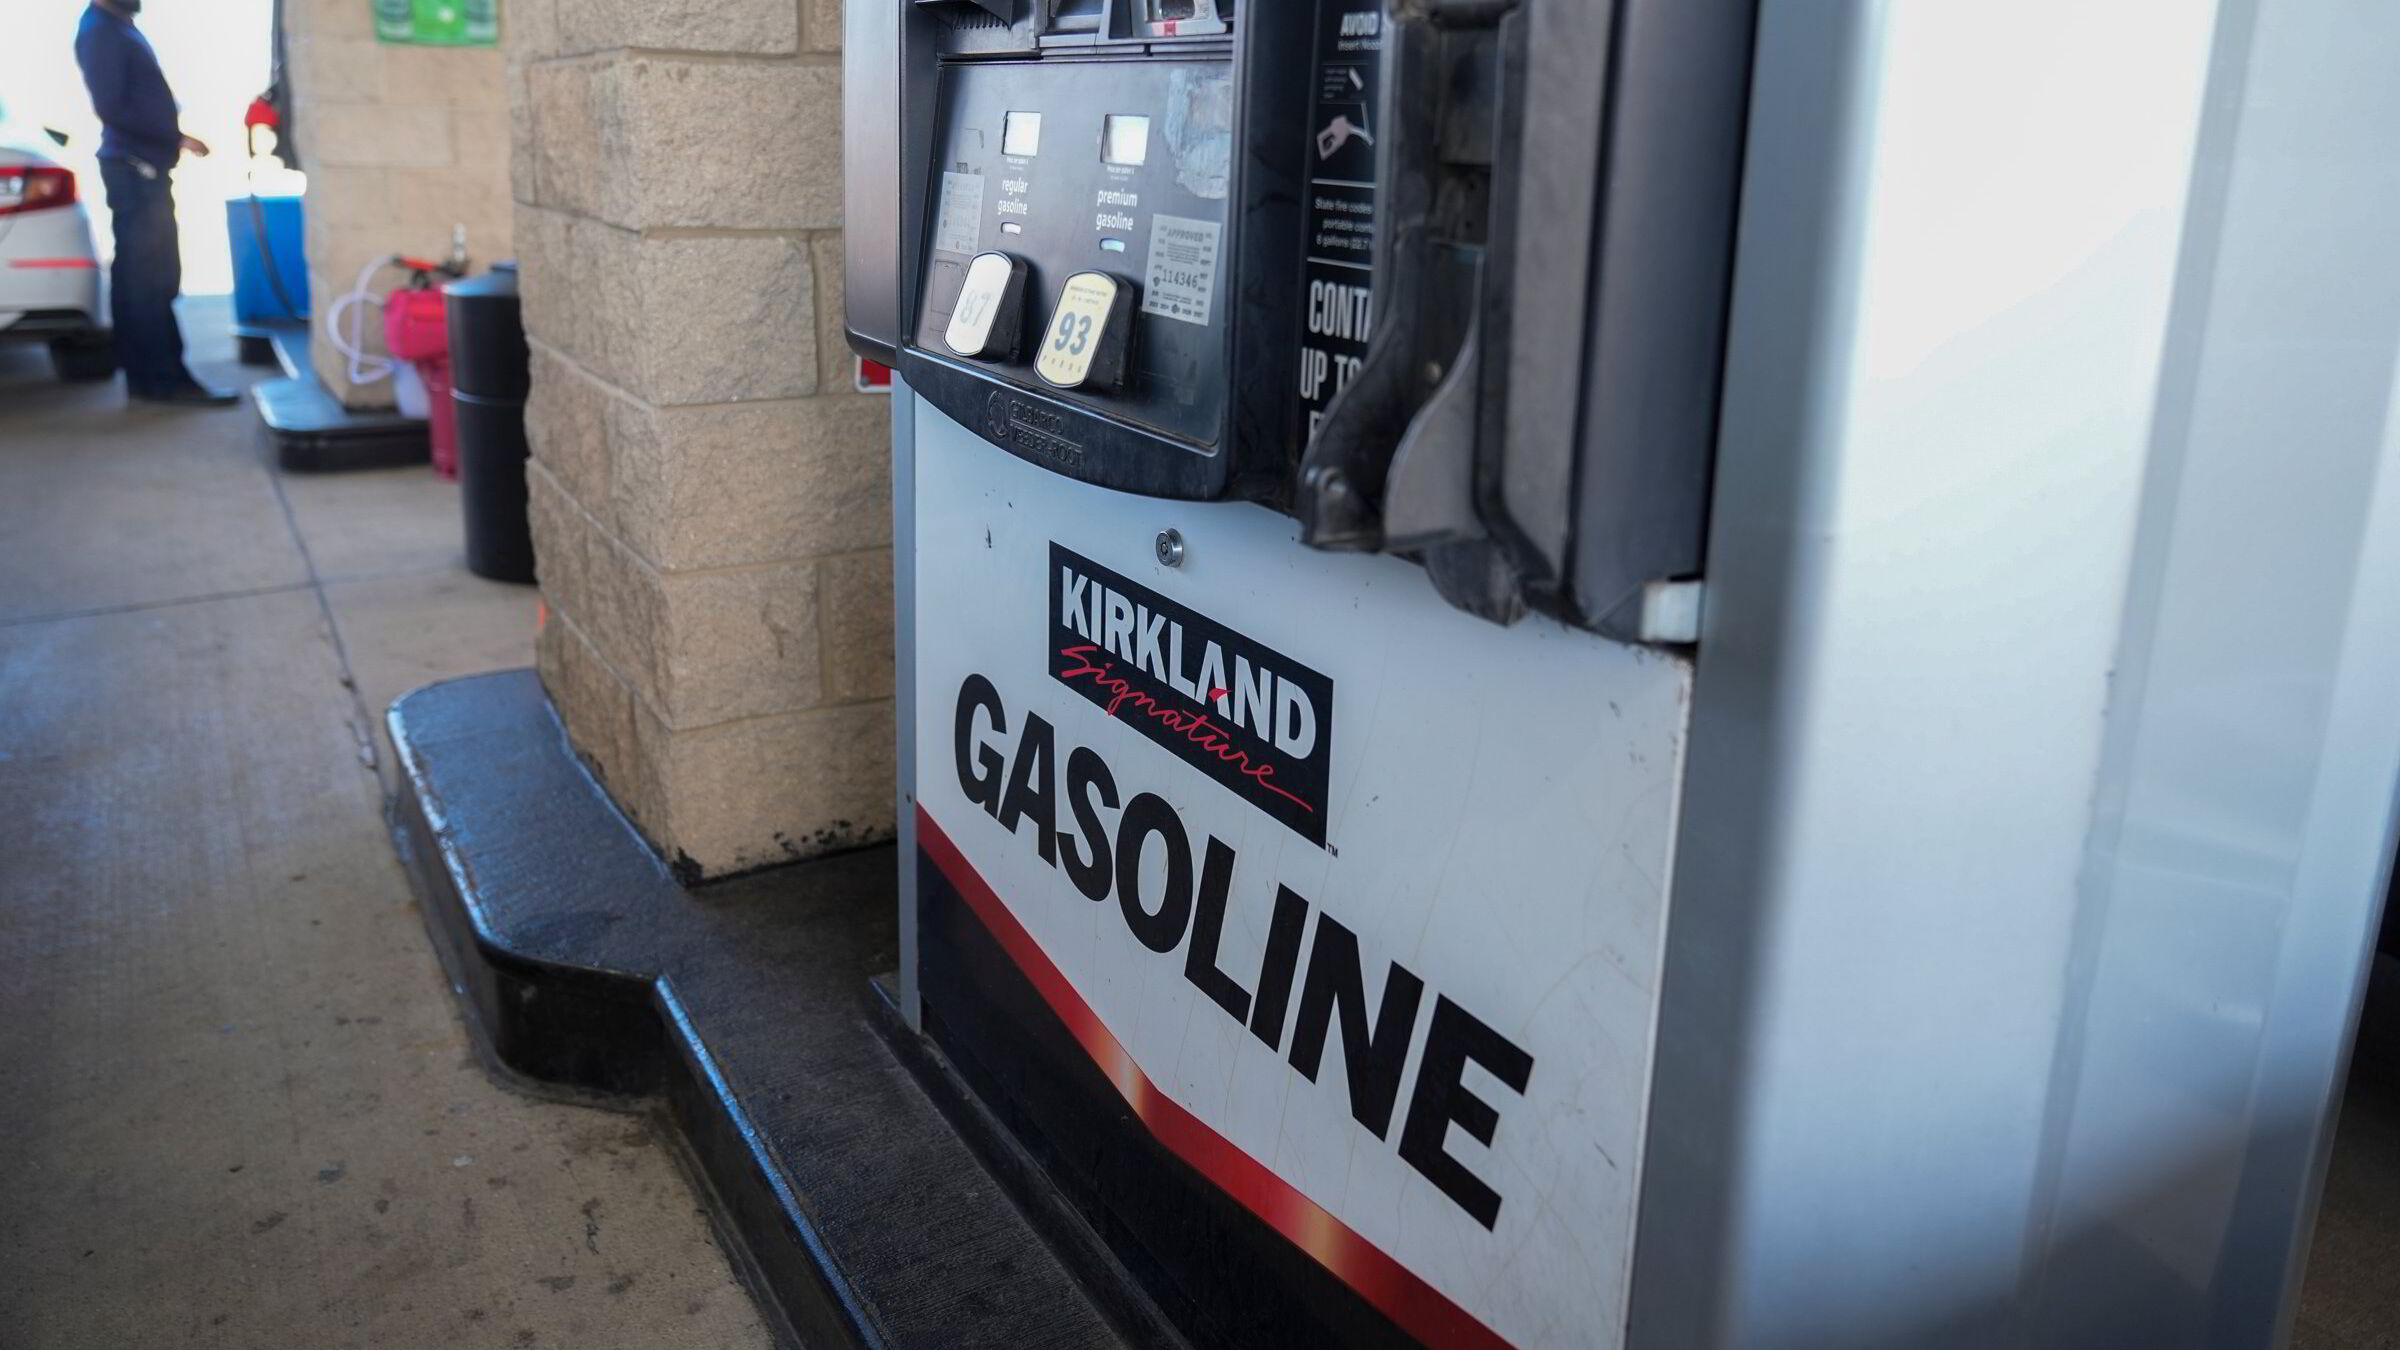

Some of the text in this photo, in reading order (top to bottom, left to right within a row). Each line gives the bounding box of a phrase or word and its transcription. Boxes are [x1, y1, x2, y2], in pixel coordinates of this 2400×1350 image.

[1340, 11, 1380, 37] AVOID
[1001, 177, 1028, 196] regular
[1096, 188, 1138, 207] premium
[998, 198, 1028, 215] gasoline
[1096, 211, 1134, 231] gasoline
[1162, 268, 1198, 289] 114346
[1055, 311, 1092, 355] 93
[1300, 347, 1328, 401] UP
[1061, 567, 1317, 760] KIRKLAND
[1060, 644, 1313, 812] Signature
[954, 673, 1535, 1233] GASOLINE
